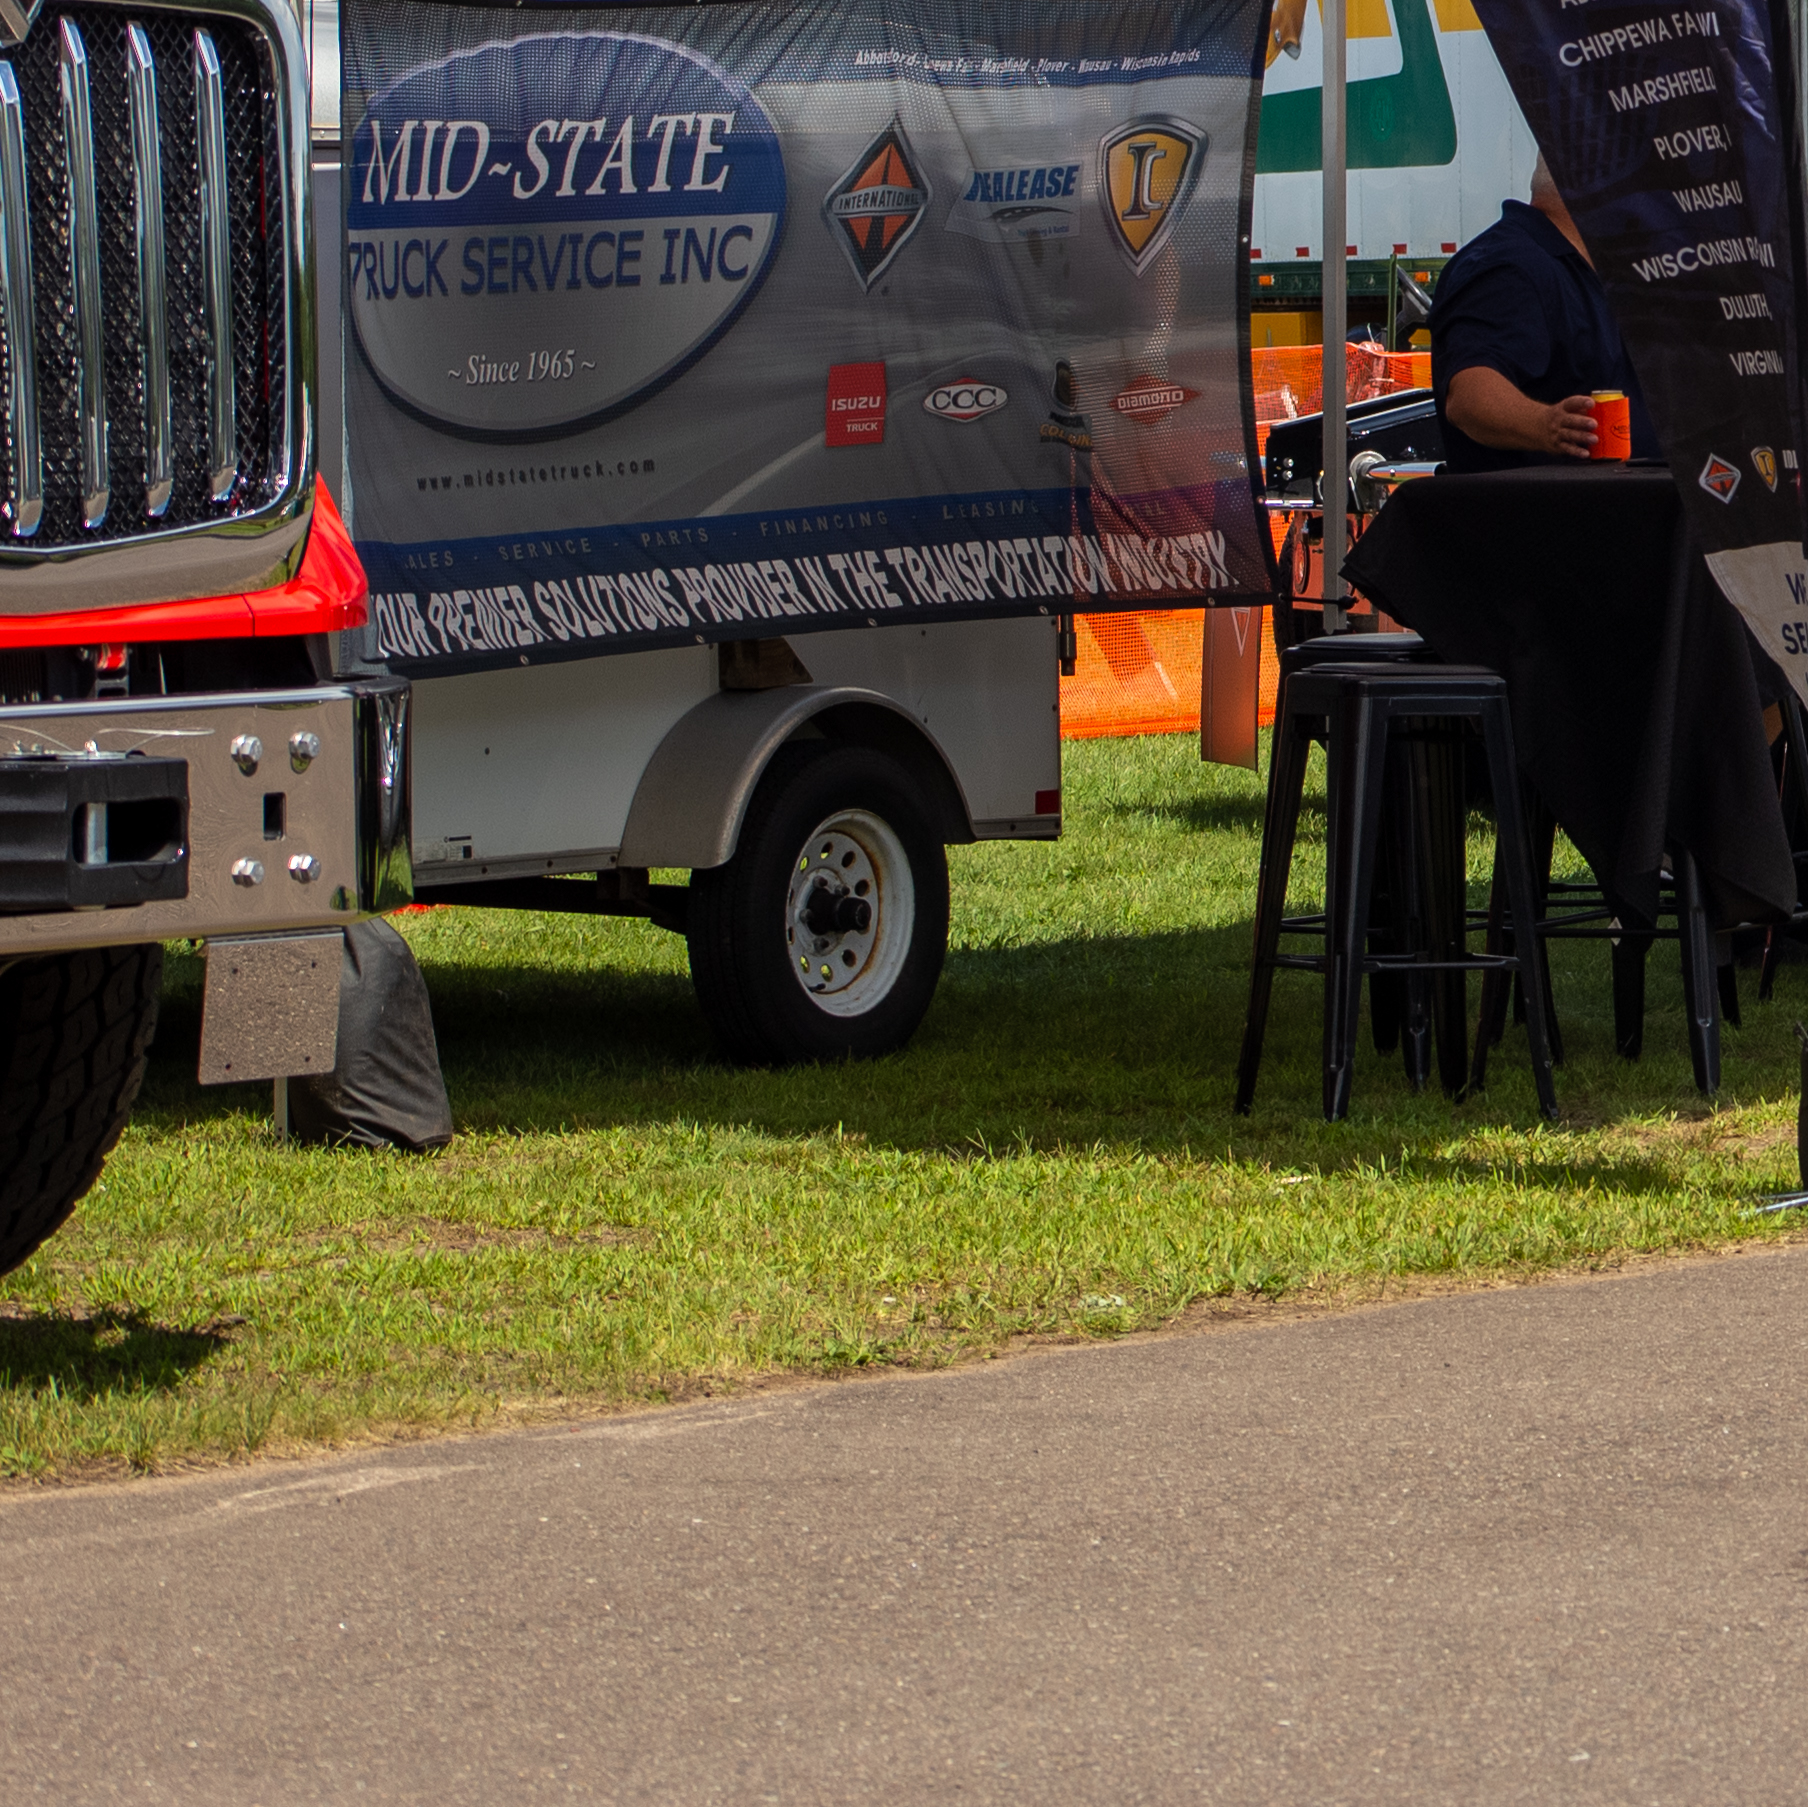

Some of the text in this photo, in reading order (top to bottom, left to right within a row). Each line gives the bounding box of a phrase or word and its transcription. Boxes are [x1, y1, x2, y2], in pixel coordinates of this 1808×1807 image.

[1035, 58, 1070, 73] Plover
[1121, 53, 1169, 72] Wisconsin
[1167, 48, 1201, 67] Rapids
[1559, 17, 1673, 67] CHIPPEWA
[837, 191, 921, 210] INTERNATIONAL
[460, 229, 642, 295] SERVICE
[659, 224, 755, 285] INC
[1632, 237, 1748, 283] WISCONSIN
[466, 348, 577, 385] Since 1965
[831, 395, 881, 412] ISUZU
[930, 387, 998, 411] CCC
[846, 422, 878, 434] TRUCK
[416, 456, 656, 493] www.midstatetruck.com
[405, 498, 1040, 569] ALES SERVICE PARTS FINANCING LEASING
[372, 530, 1240, 658] OUR PREMIER SOLUTIONS PROVIDER IN THE TRANSPORTATION INDUSTRY
